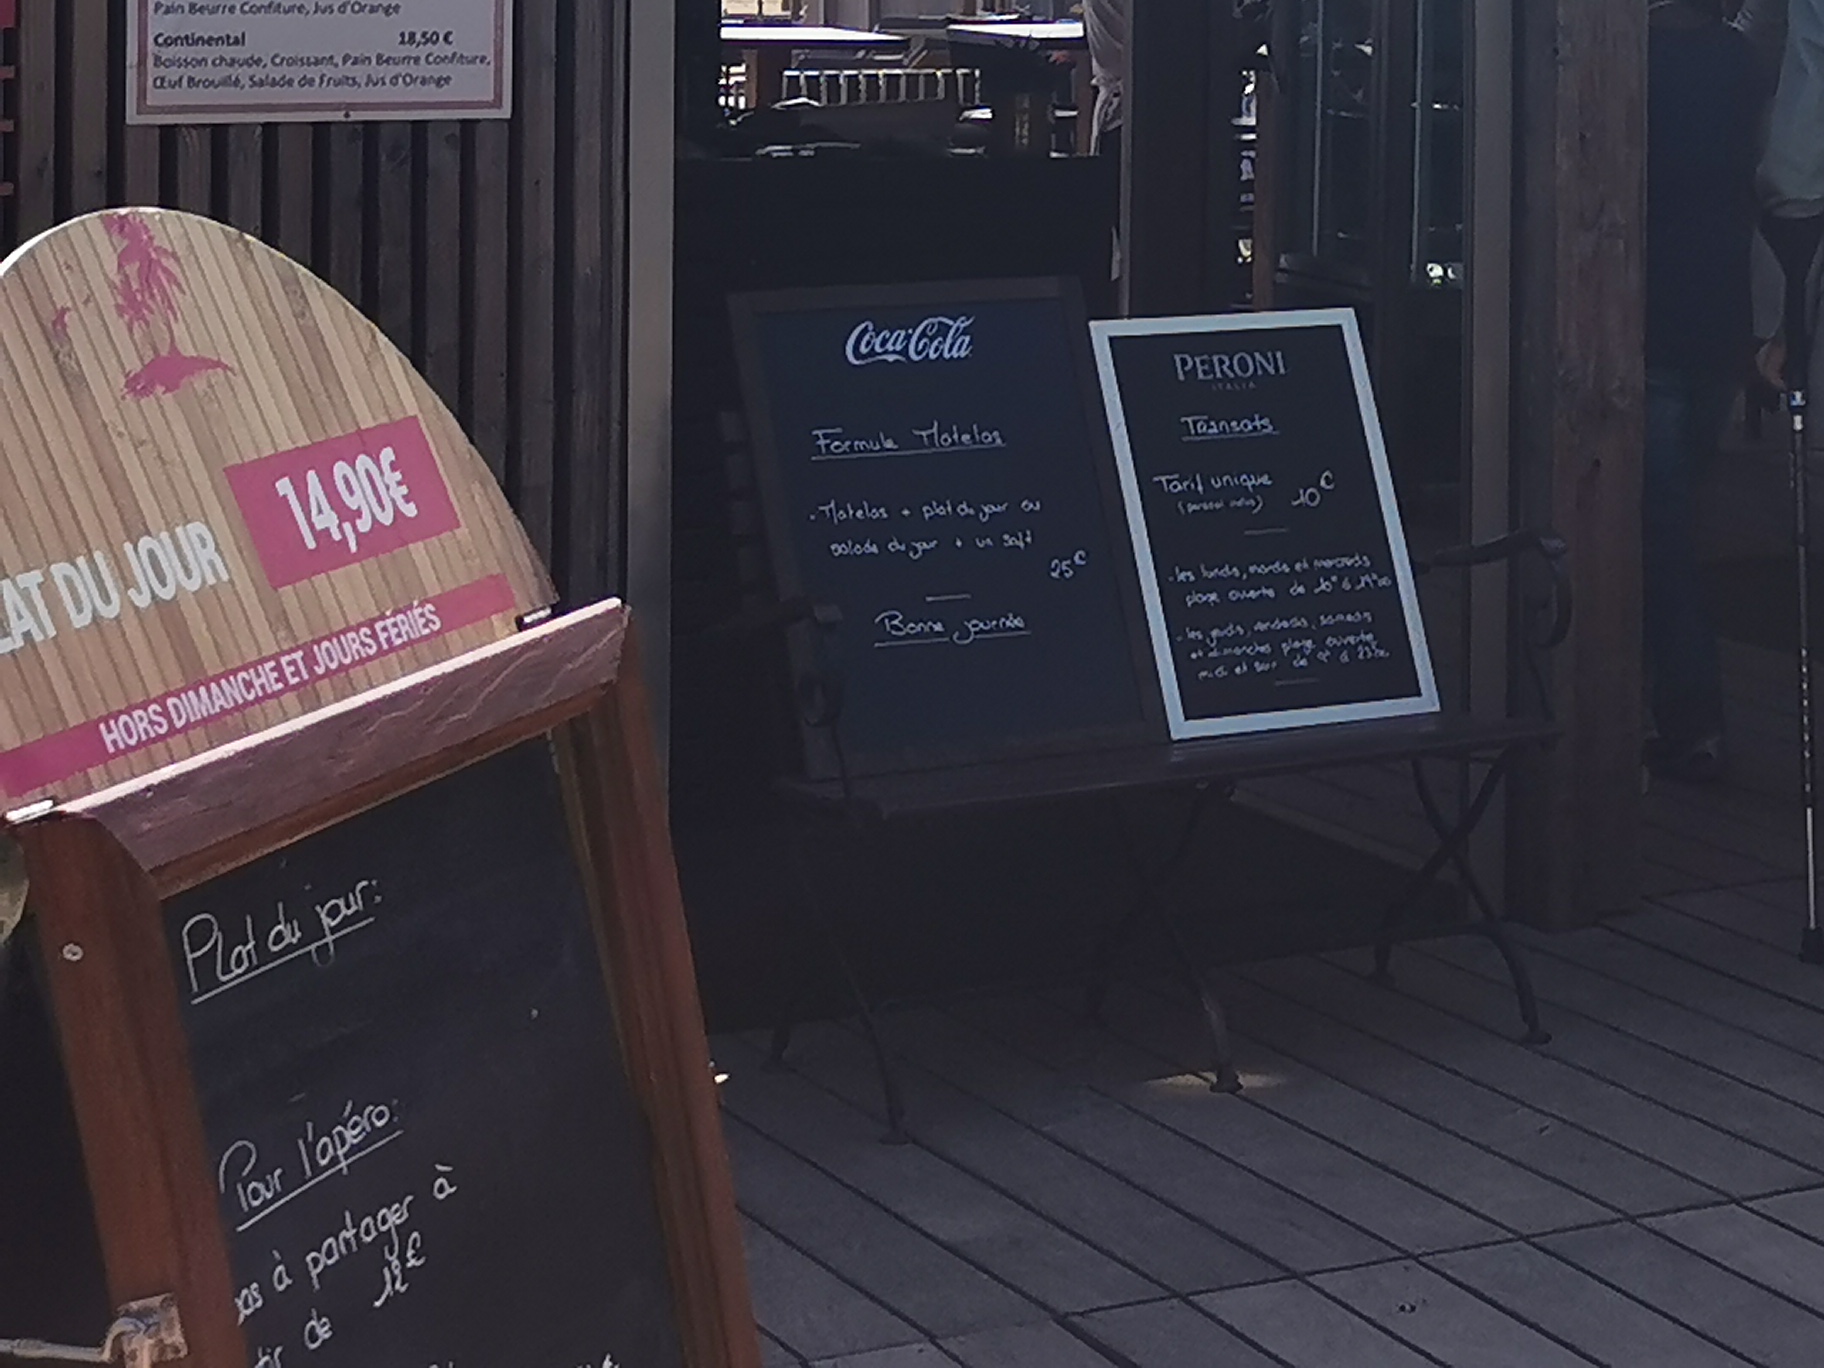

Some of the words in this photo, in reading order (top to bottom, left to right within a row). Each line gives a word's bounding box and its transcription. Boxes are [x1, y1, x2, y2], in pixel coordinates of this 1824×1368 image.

[154, 1, 185, 15] Pain
[188, 1, 237, 16] Beurre
[239, 0, 310, 18] Confiture,
[312, 1, 335, 16] Jus
[337, 0, 401, 17] d'Orange
[153, 31, 246, 48] Continental
[398, 30, 440, 48] 18,50
[443, 30, 454, 46] €
[152, 53, 208, 69] Boisson
[211, 54, 267, 69] chaude,
[270, 53, 339, 69] Croissant,
[341, 52, 372, 67] Pain
[375, 52, 421, 67] Beurre
[248, 73, 295, 89] Salade
[297, 73, 316, 89] de
[364, 73, 387, 88] Jus
[389, 72, 453, 89] d'Orange
[1173, 350, 1287, 381] PERONI
[811, 427, 900, 455] Formule
[274, 445, 418, 554] 14,90€
[1152, 473, 1205, 496] Tarif
[1210, 472, 1274, 494] unique
[922, 498, 953, 521] plat
[49, 549, 121, 629] DU
[125, 520, 229, 610] JOUR
[98, 704, 169, 755] HORS
[165, 662, 284, 730] DIMANCHE
[282, 650, 315, 684] ET
[312, 627, 379, 676] JOURS
[374, 600, 442, 652] FÉRIÉS
[182, 912, 257, 994] Plat
[267, 901, 303, 953] du
[218, 1139, 284, 1213] Pour
[271, 1248, 293, 1293] à
[304, 1194, 415, 1292] partager
[431, 1163, 458, 1200] à
[303, 1307, 335, 1352] de
